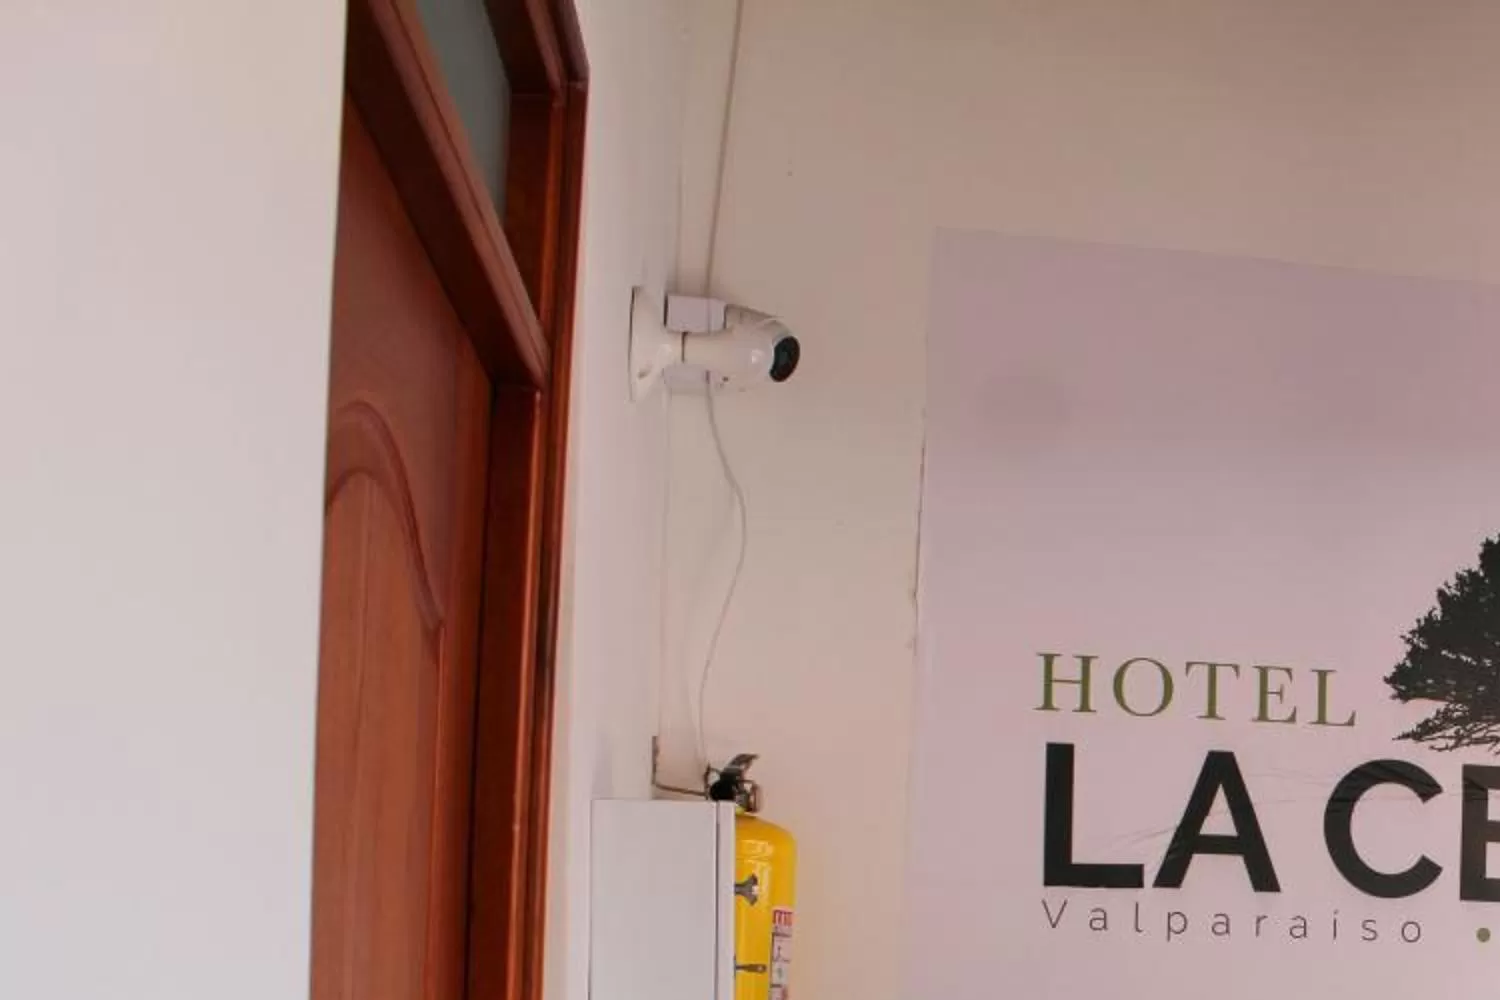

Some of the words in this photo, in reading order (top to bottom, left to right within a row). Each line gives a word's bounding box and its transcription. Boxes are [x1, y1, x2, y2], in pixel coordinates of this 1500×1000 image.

[1034, 652, 1357, 728] HOTEL
[1042, 741, 1282, 895] LA
[1041, 897, 1423, 944] Valparaiso
